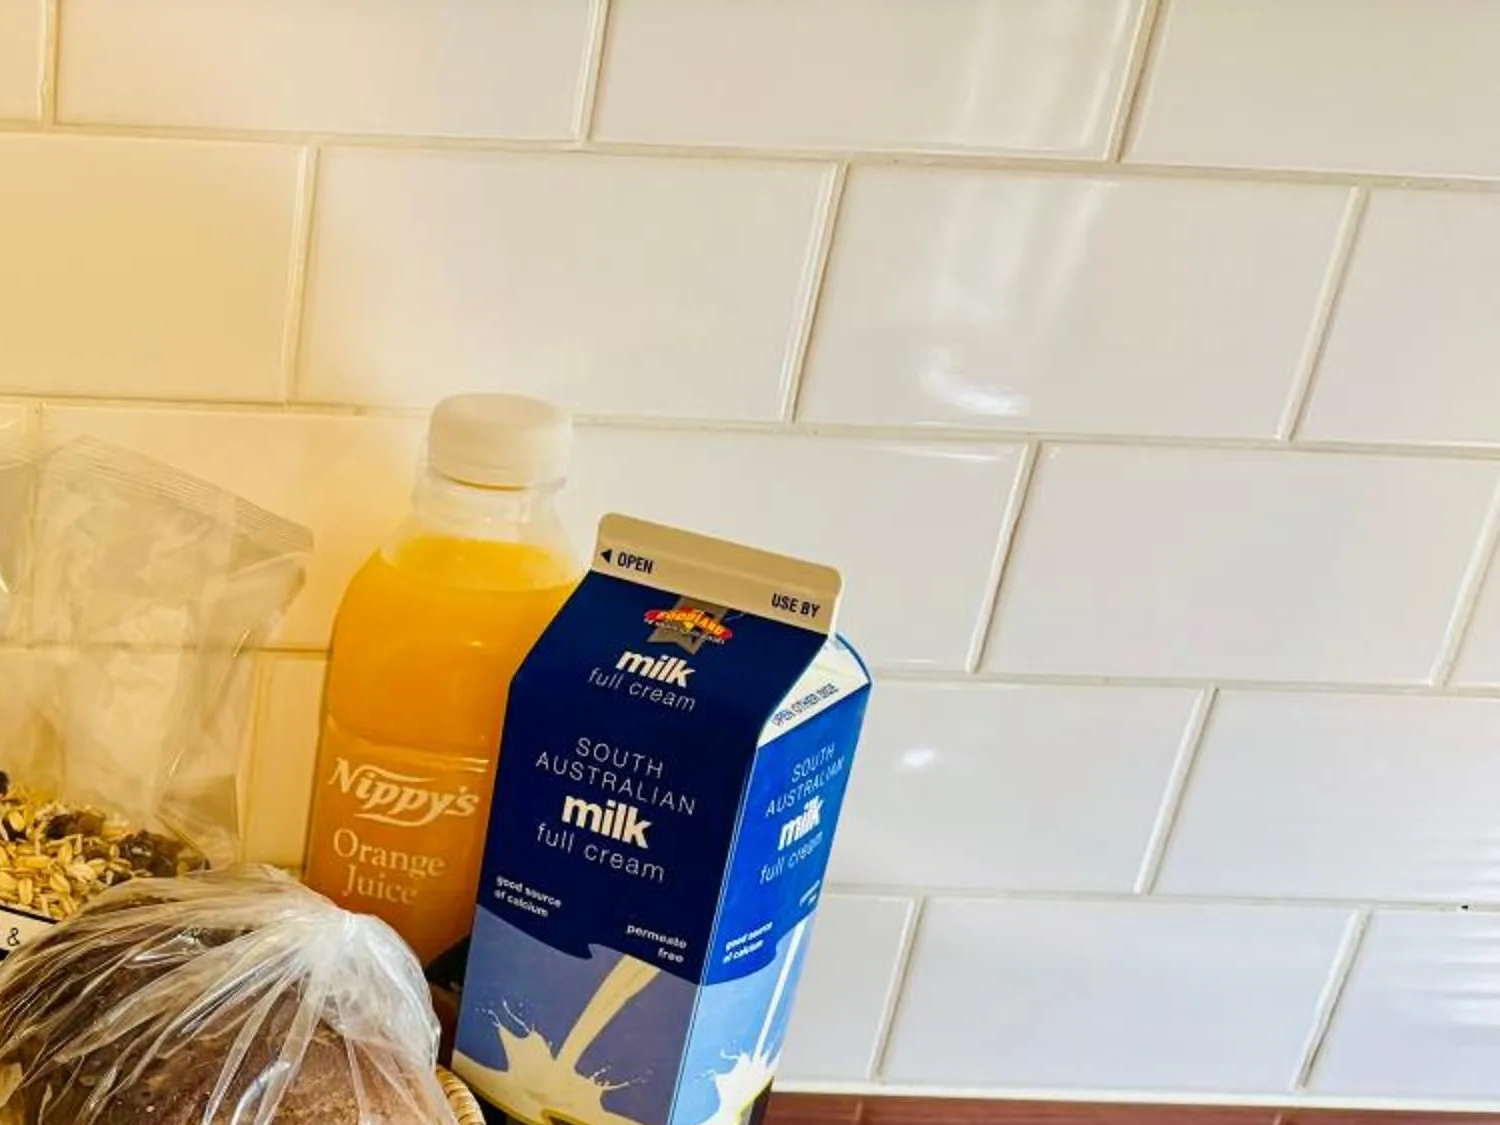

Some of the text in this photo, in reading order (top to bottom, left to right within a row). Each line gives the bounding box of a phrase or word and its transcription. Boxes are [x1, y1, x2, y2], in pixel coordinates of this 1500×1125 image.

[617, 551, 821, 618] OPEN USE BY
[588, 667, 697, 712] full cream
[615, 650, 696, 688] milk
[771, 709, 795, 727] OPEN
[575, 736, 664, 779] SOUTH
[791, 741, 836, 784] SOUTH
[328, 756, 480, 827] Nippy's
[535, 750, 696, 816] AUSTRALIAN
[765, 755, 845, 818] AUSTRALIAN
[561, 793, 653, 849] milk
[777, 795, 825, 851] milk
[333, 828, 446, 879] Orange
[537, 822, 665, 883] full cream
[342, 864, 419, 904] Juice
[494, 889, 549, 918] of calcium
[496, 875, 562, 908] good source
[7, 927, 21, 947] &
[626, 924, 688, 950] permeate
[658, 947, 685, 964] free
